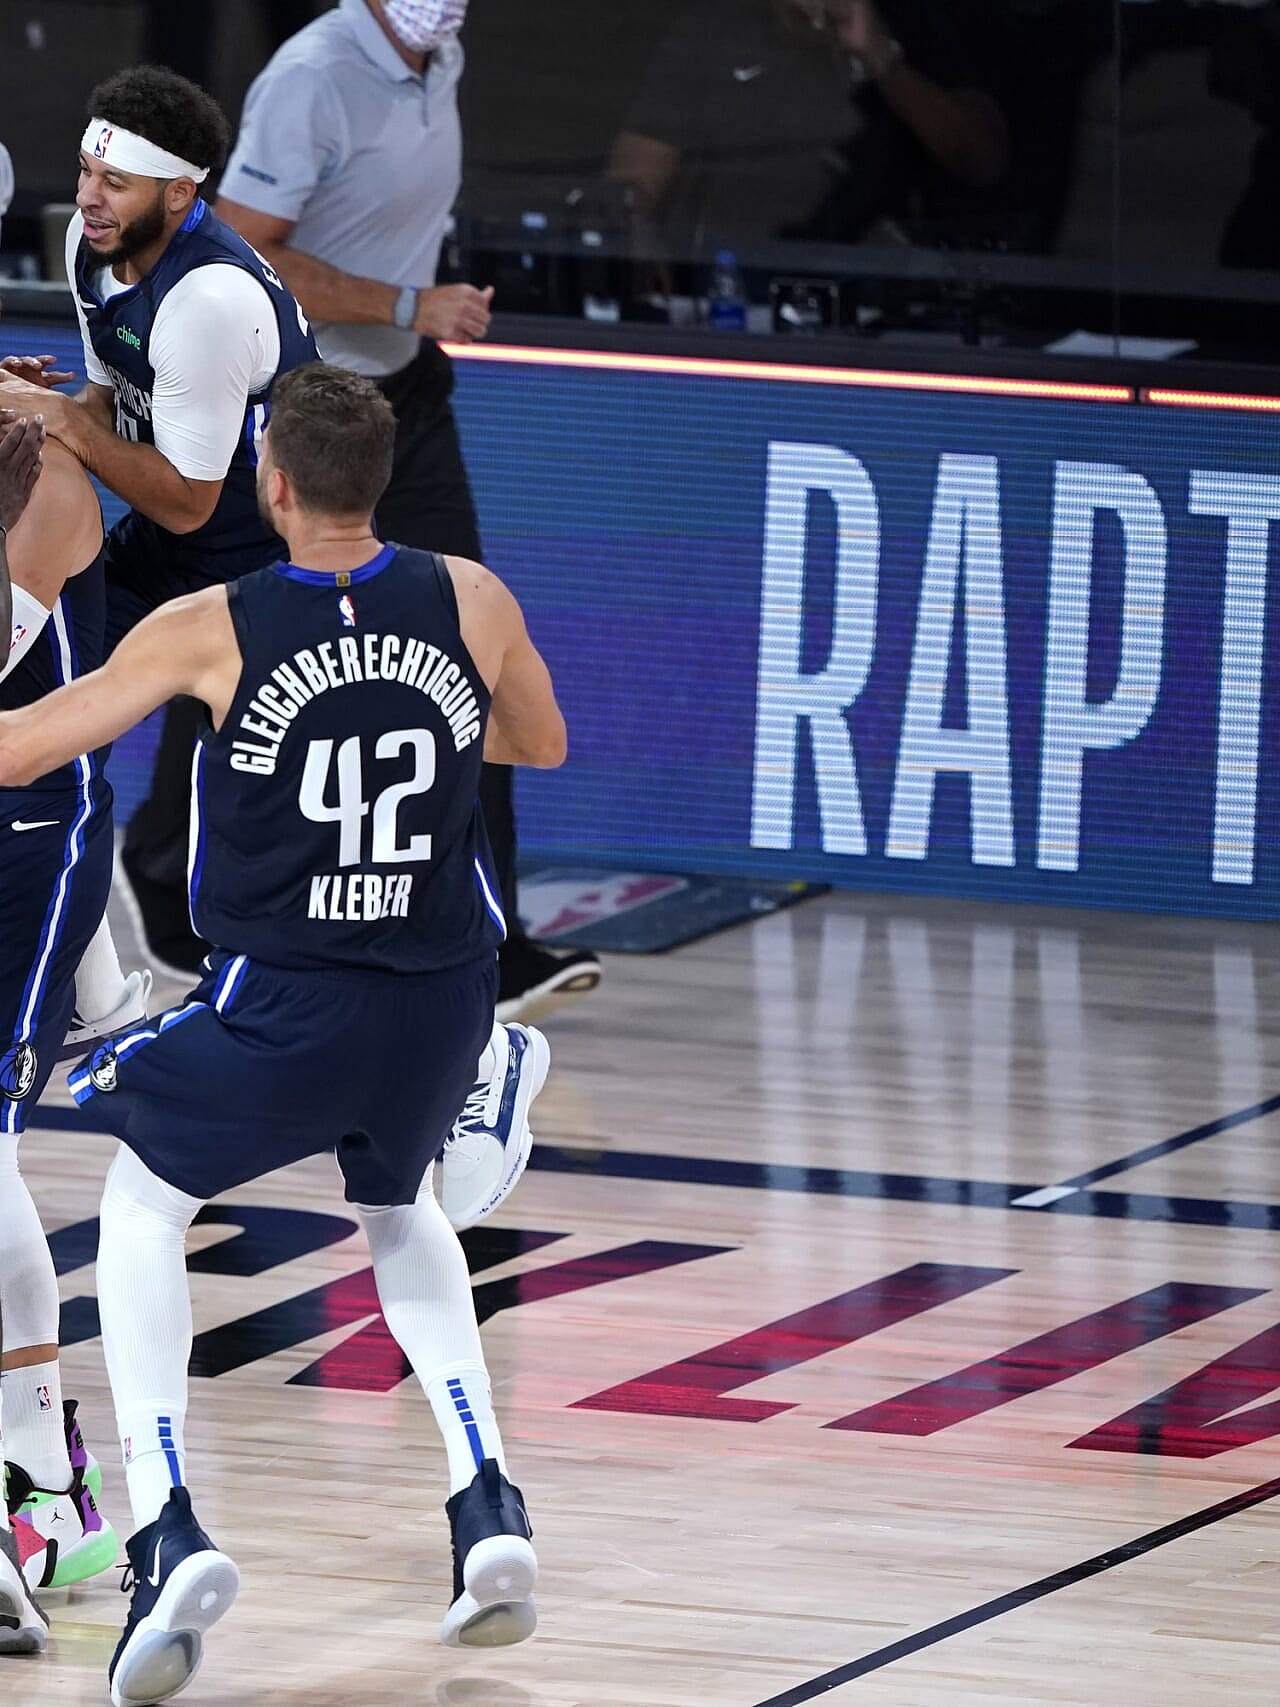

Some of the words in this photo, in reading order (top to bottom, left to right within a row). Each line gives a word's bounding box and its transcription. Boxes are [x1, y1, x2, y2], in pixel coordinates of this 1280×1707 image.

[116, 324, 141, 350] chime
[230, 633, 481, 776] GLEICHBERECHTIGUNG
[750, 440, 1280, 885] RAPT
[298, 728, 436, 867] 42
[307, 873, 413, 921] KLEBER
